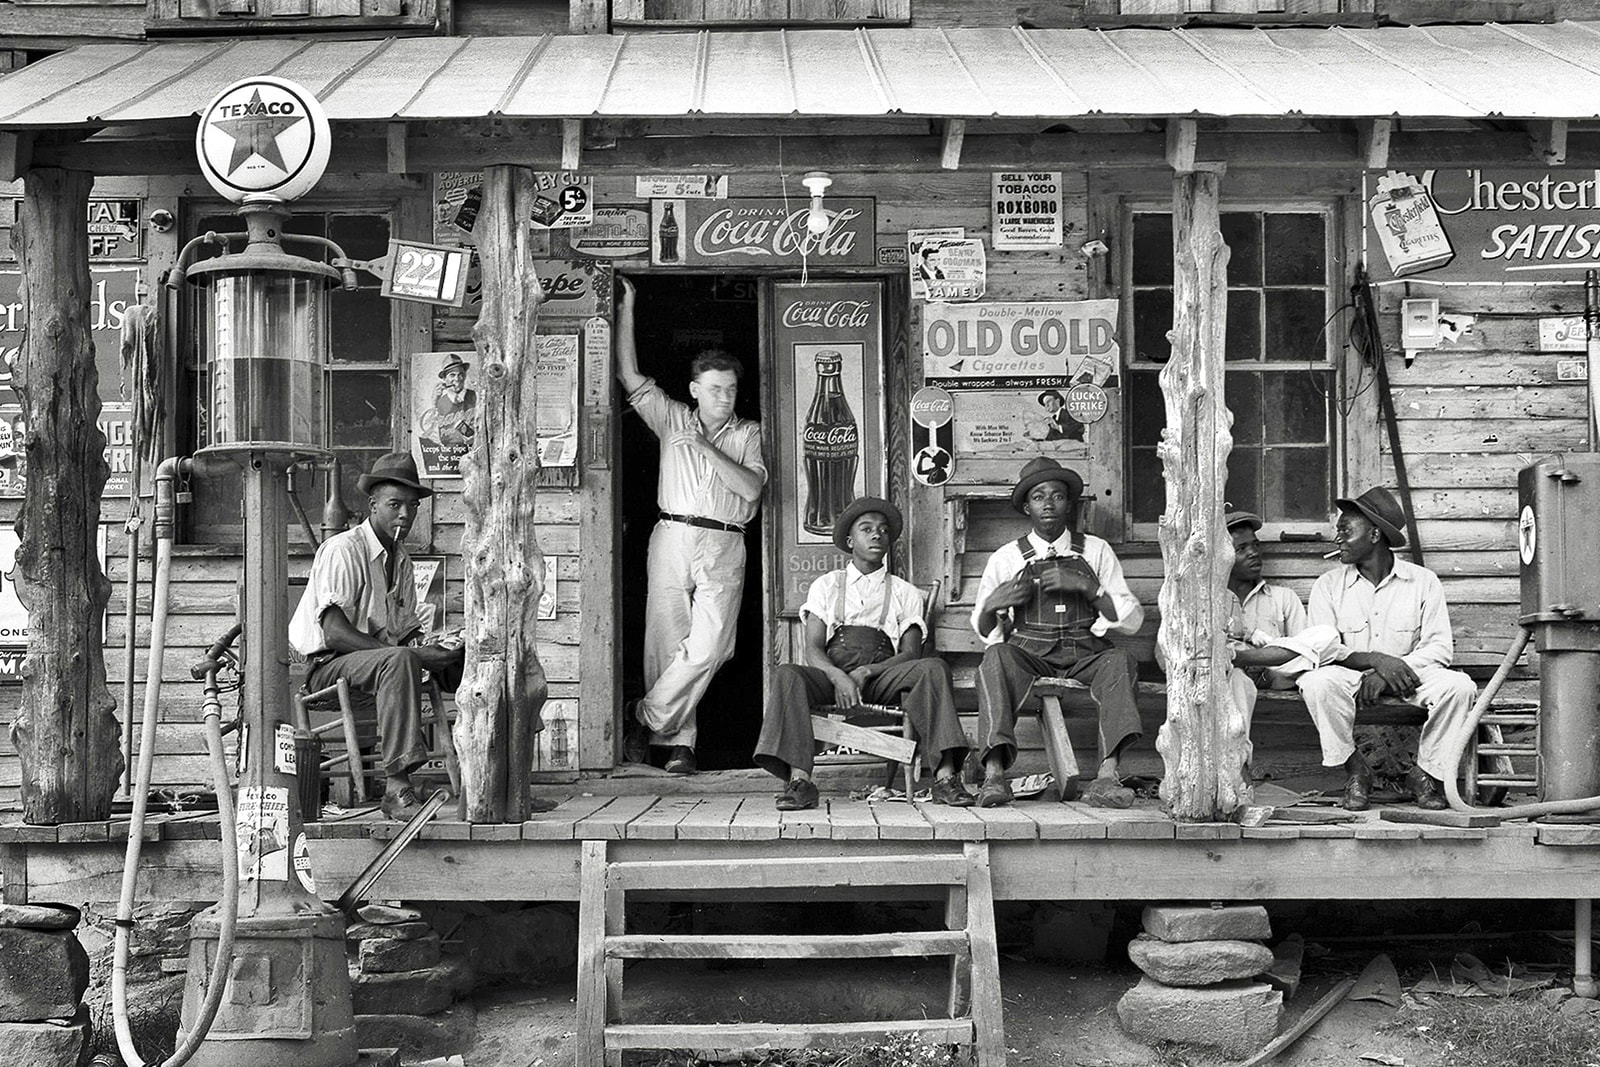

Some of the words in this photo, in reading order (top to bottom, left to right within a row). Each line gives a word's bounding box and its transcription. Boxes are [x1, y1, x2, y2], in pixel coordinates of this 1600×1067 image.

[220, 102, 295, 118] TEXACO
[1001, 174, 1024, 182] SELL
[997, 184, 1056, 194] TOBACCO
[738, 208, 786, 217] DRINK
[997, 200, 1057, 214] ROXBORO
[597, 210, 629, 218] DRINK
[89, 224, 118, 233] CHEW
[693, 208, 863, 256] Coca-Cola
[1481, 224, 1600, 260] SATIS
[947, 248, 975, 257] BENNY
[942, 258, 983, 267] GOODMAN
[538, 273, 585, 300] ape
[928, 287, 980, 297] CAMEL
[782, 300, 871, 328] Coca-Cola
[1555, 318, 1586, 341] PEP
[927, 319, 1003, 357] OLD
[1010, 318, 1114, 356] GOLD
[972, 360, 1045, 374] Cigarettes
[932, 380, 959, 388] Double
[1005, 379, 1034, 387] always
[1036, 378, 1067, 387] FRESH!
[1072, 391, 1101, 400] LUCKY
[913, 399, 949, 412] Coca-Cola
[1070, 401, 1104, 411] STRIKE
[804, 425, 857, 444] Coca-Cola
[789, 554, 828, 571] Sold
[428, 760, 446, 768] IC
[246, 788, 277, 800] TEXACO
